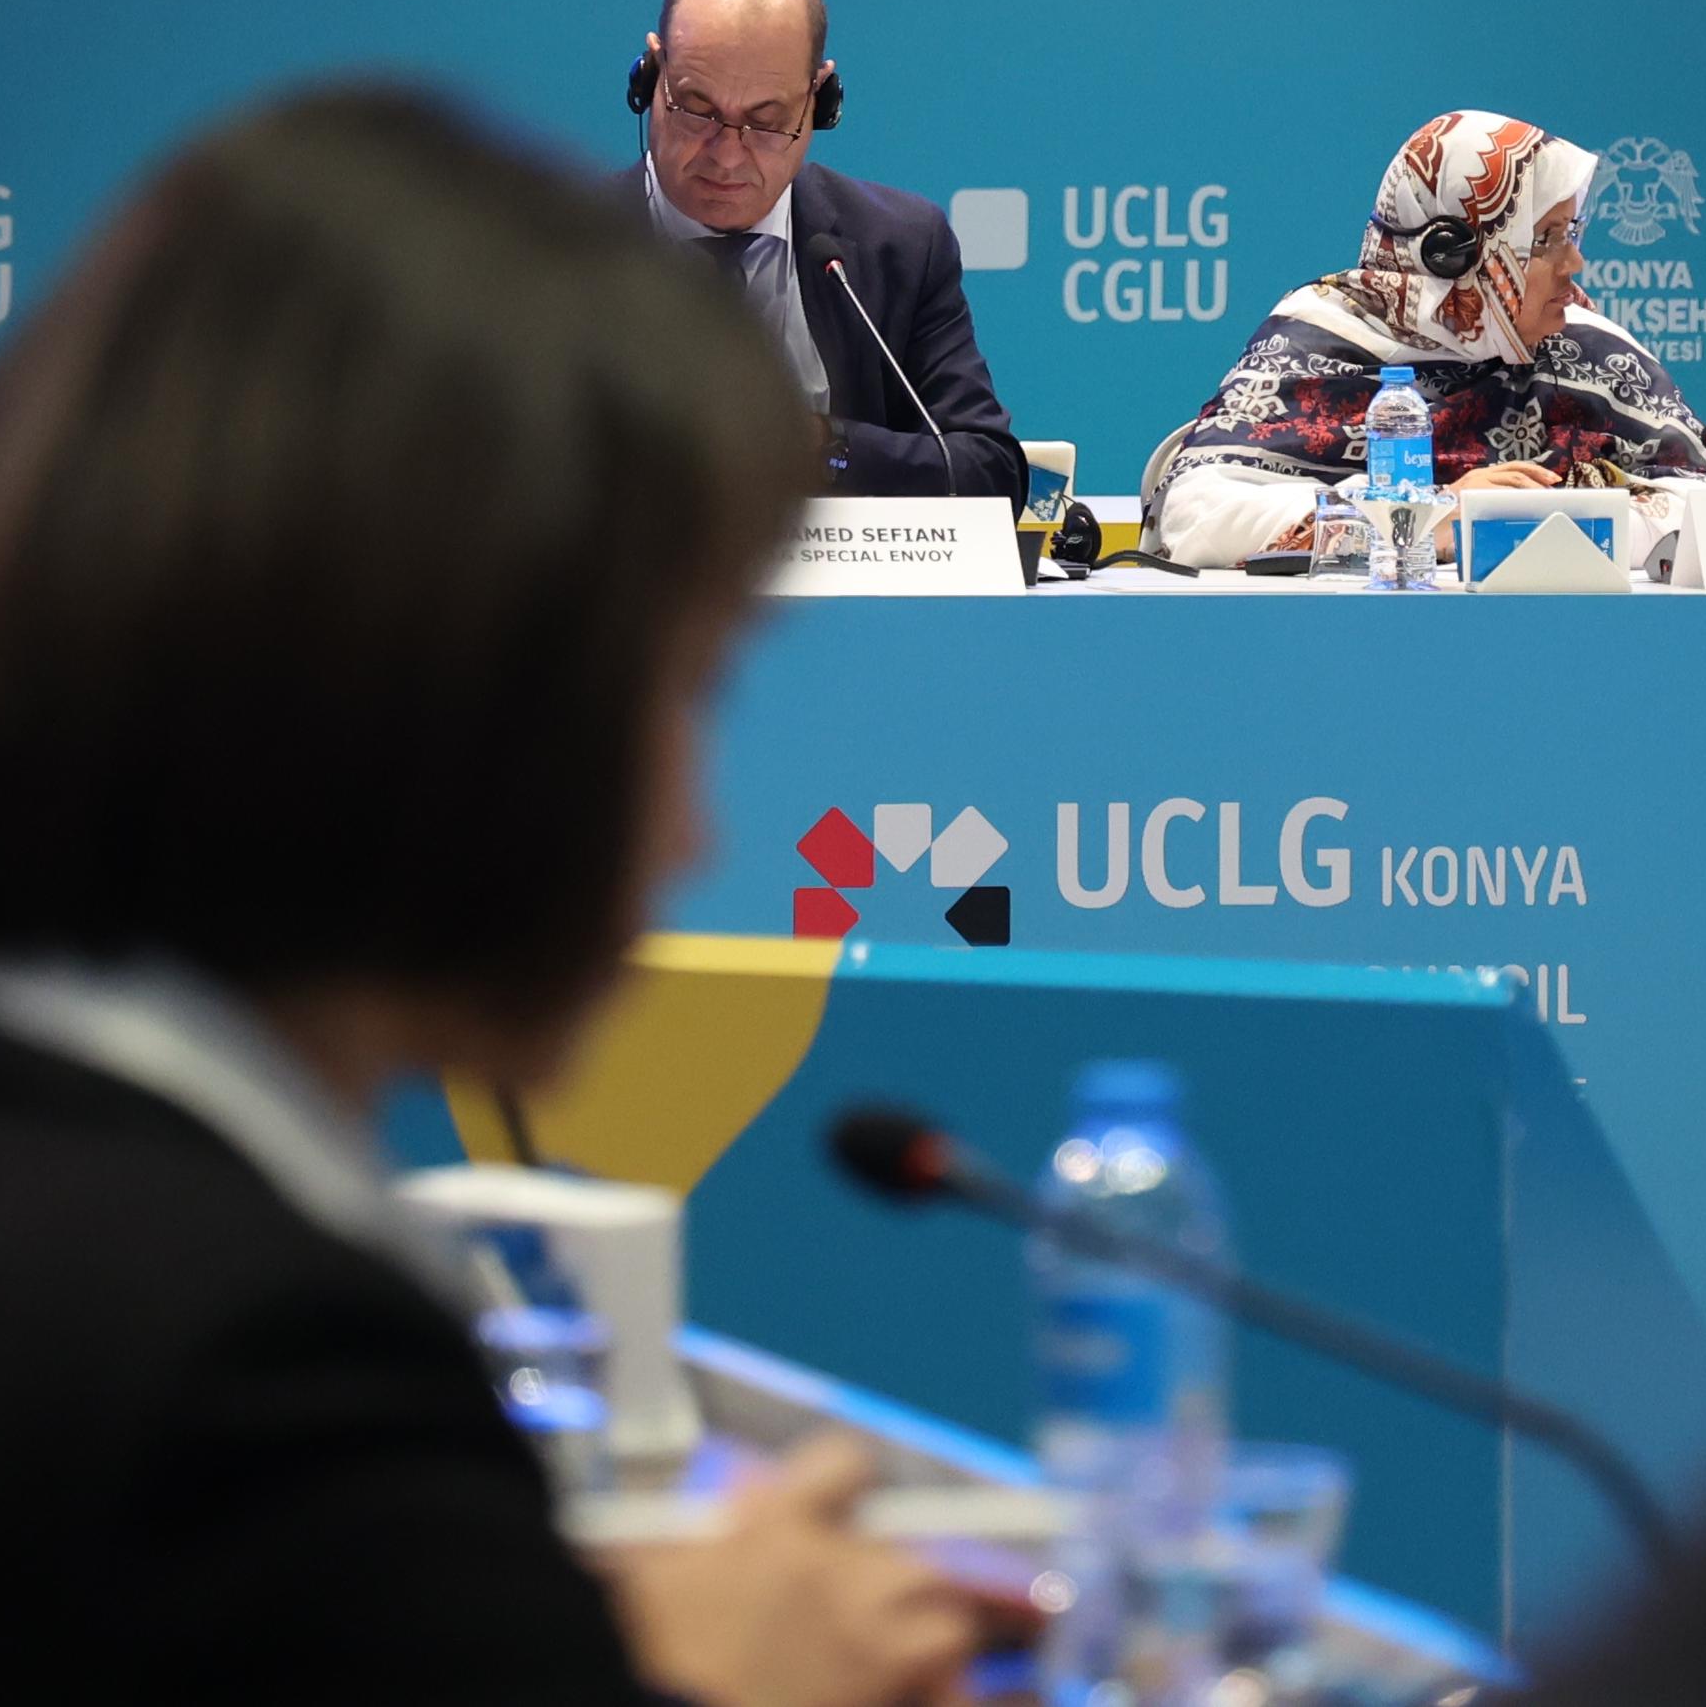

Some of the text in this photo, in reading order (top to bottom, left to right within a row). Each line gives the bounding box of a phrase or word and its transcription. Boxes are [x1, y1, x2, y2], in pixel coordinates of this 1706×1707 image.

[1063, 184, 1229, 249] UCLG
[1062, 258, 1228, 323] CGLU
[1581, 259, 1693, 290] KONYA
[799, 549, 884, 563] SPECIAL
[889, 549, 953, 562] ENVOY
[861, 527, 957, 543] SEFIANI
[1056, 796, 1587, 909] UCLG KONYA
